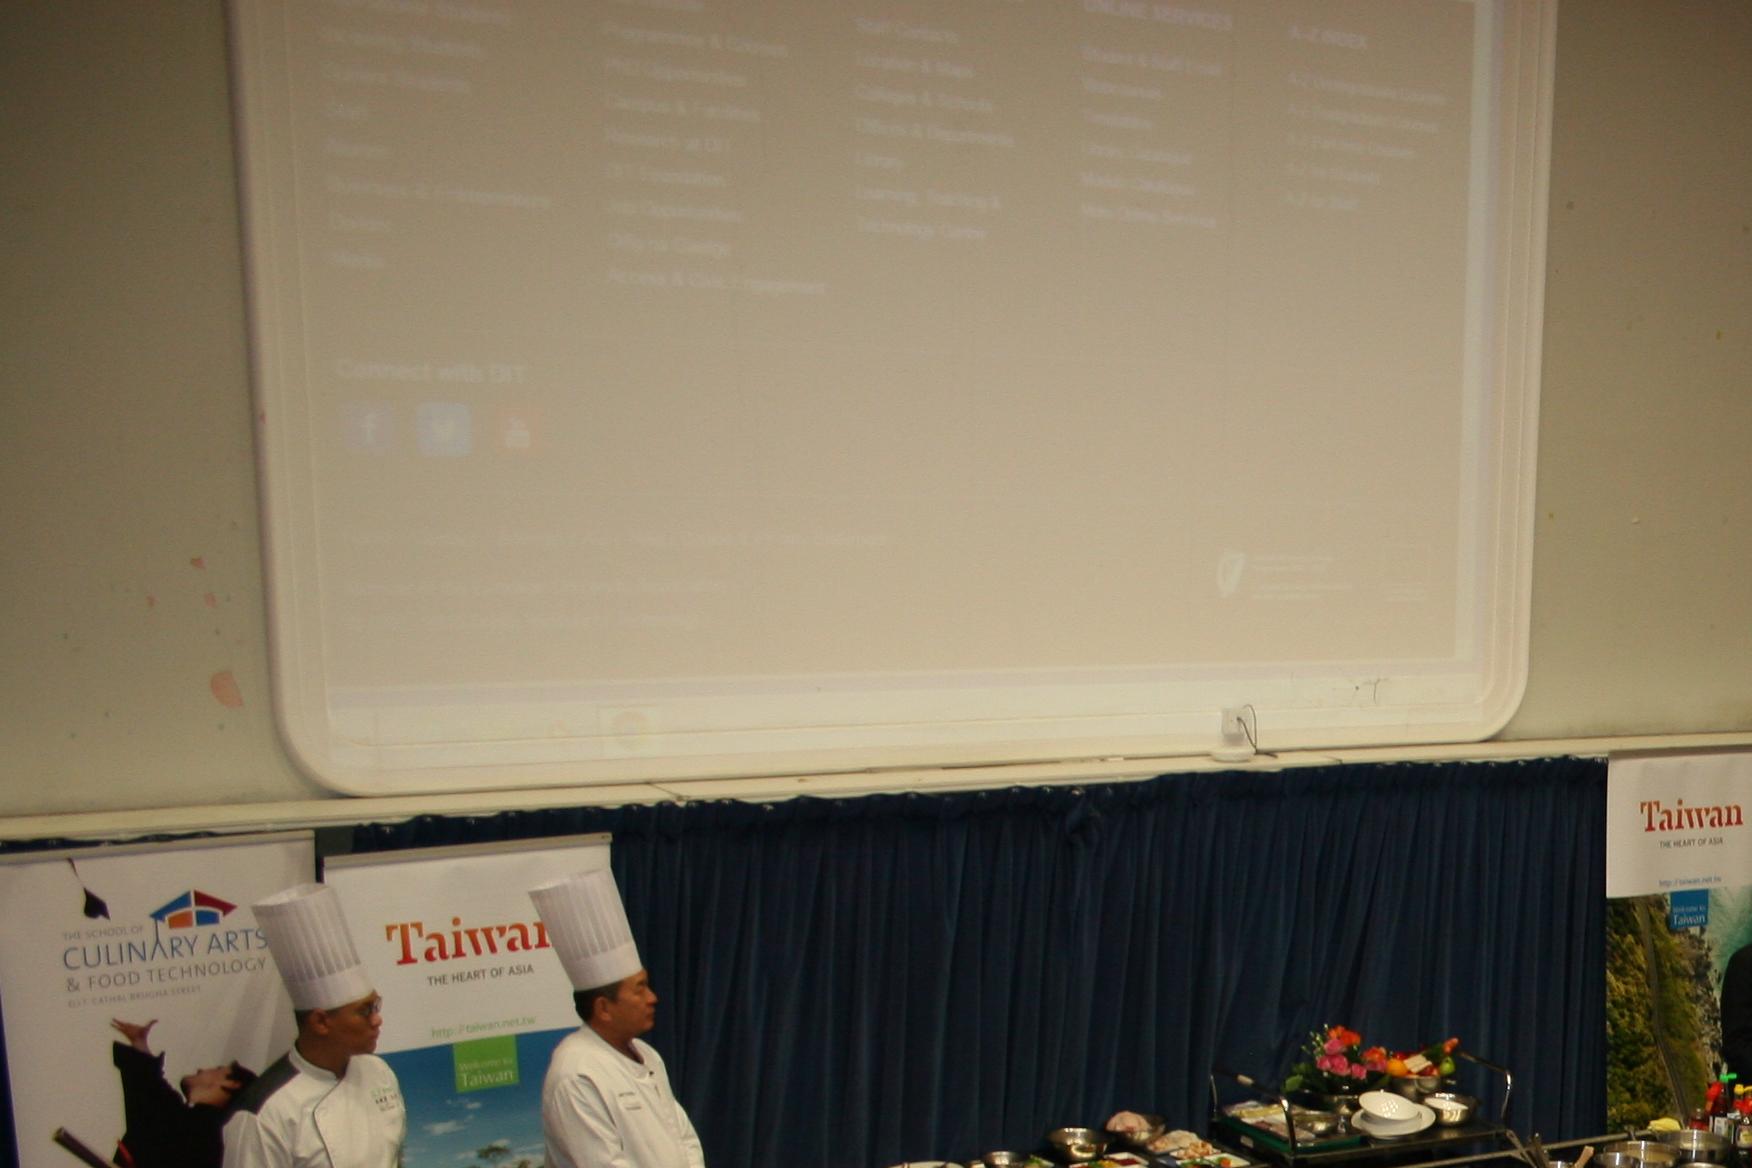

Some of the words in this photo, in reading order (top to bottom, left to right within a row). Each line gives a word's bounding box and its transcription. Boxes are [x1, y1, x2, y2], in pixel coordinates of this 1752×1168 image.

[1640, 798, 1744, 832] Taiwan
[1659, 839, 1671, 849] THE
[1673, 838, 1696, 848] HEART
[1673, 914, 1706, 926] Taiwan
[85, 927, 128, 939] SCHOOL
[63, 934, 199, 971] CULINARY
[207, 928, 268, 955] ARTS
[67, 977, 80, 993] &
[88, 971, 141, 989] FOOD
[148, 956, 268, 983] TECHNOLOGY
[427, 974, 448, 987] THE
[452, 969, 488, 984] HEART
[490, 966, 505, 978] OF
[508, 964, 535, 976] ASIA
[461, 1068, 514, 1089] Taiwan
